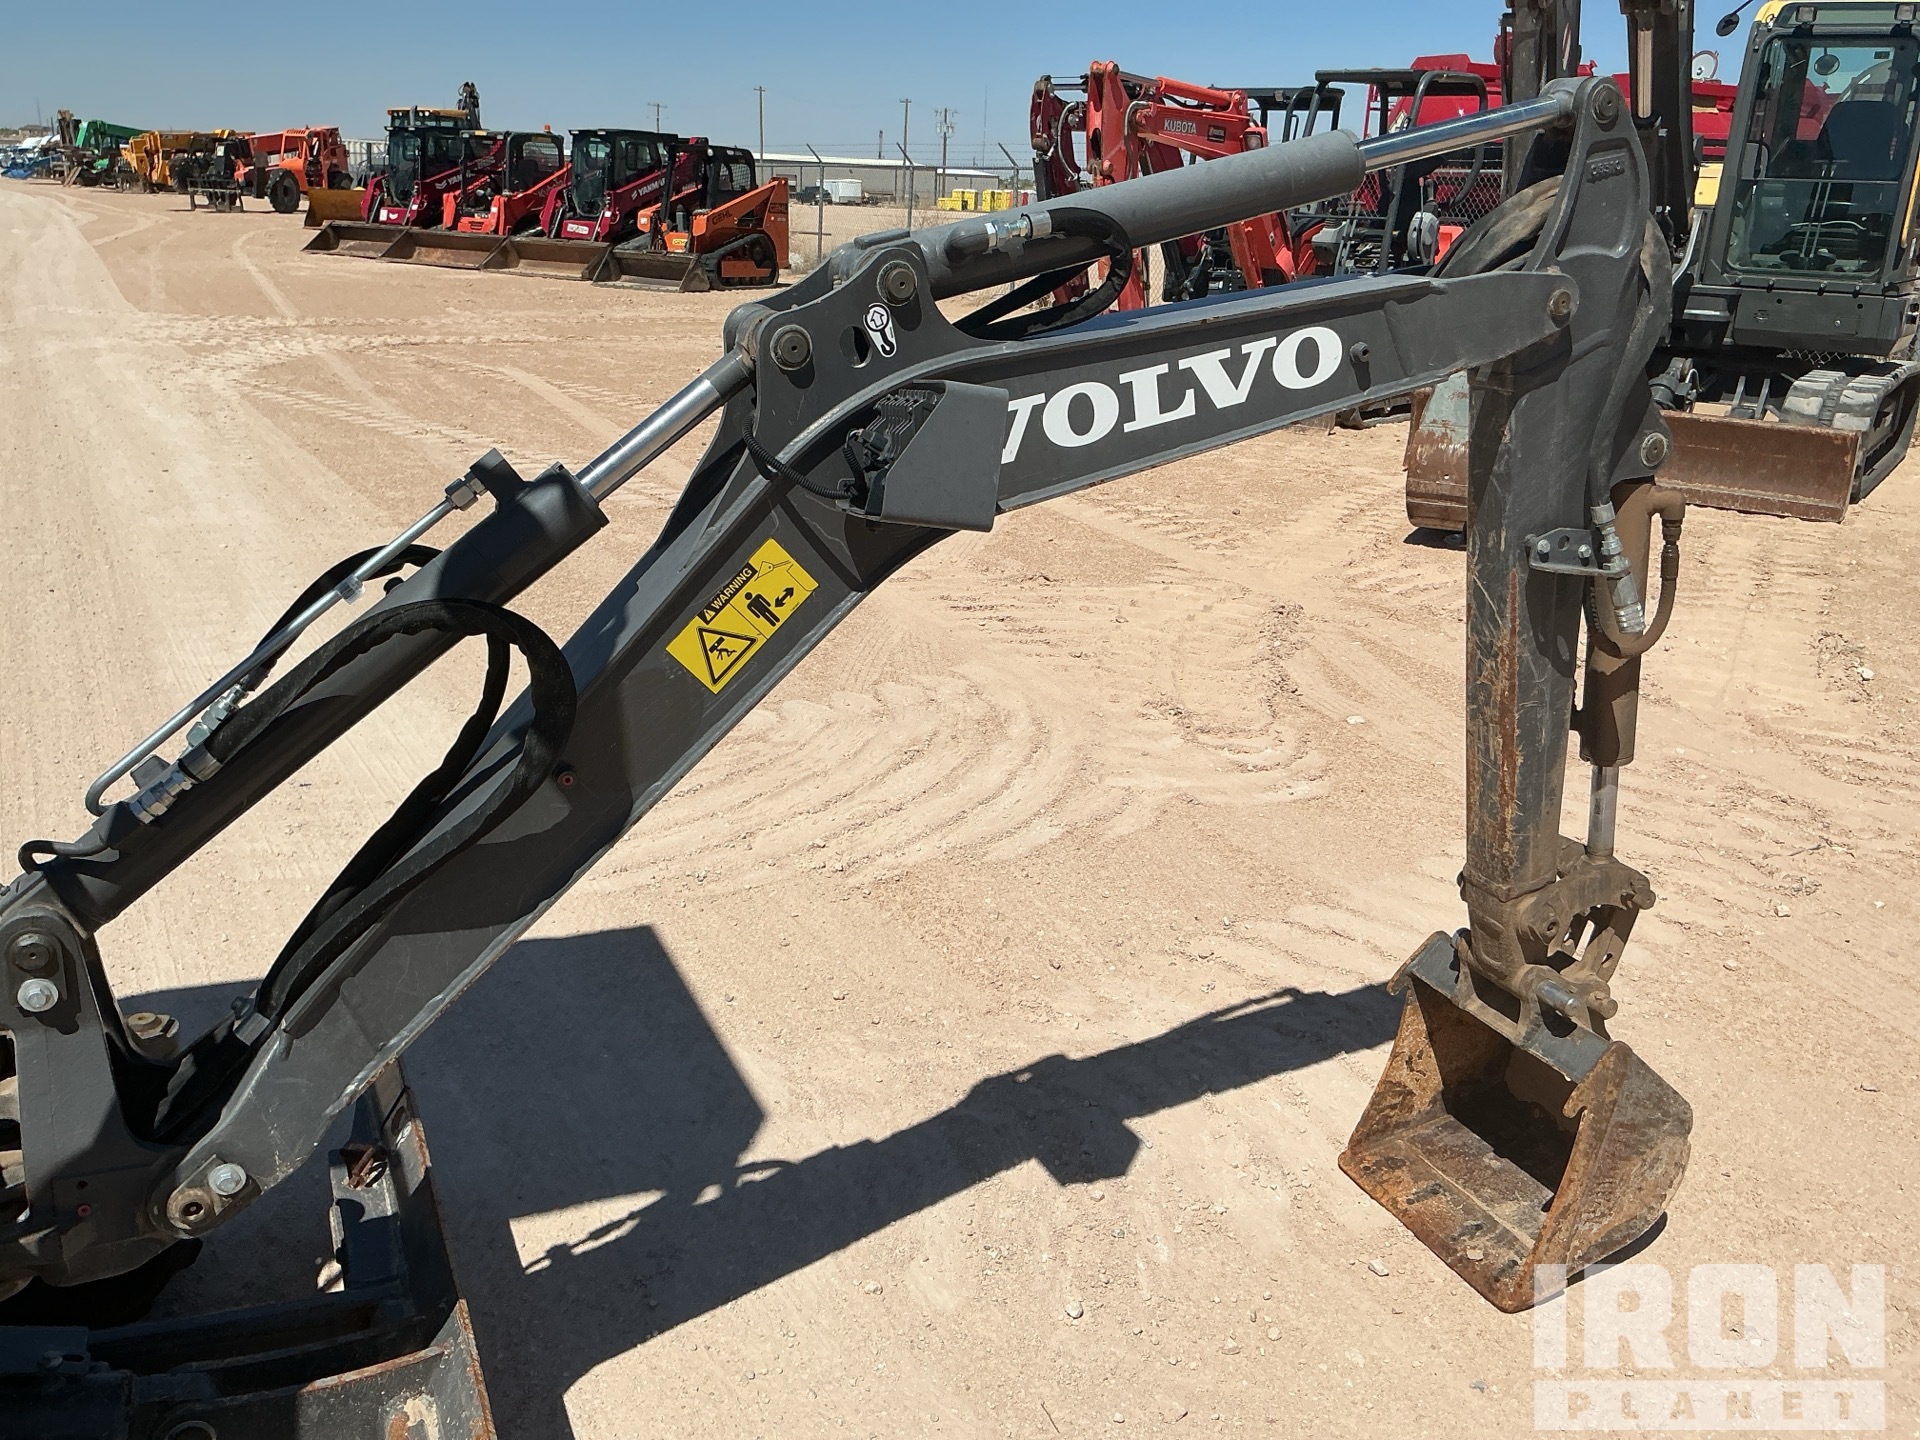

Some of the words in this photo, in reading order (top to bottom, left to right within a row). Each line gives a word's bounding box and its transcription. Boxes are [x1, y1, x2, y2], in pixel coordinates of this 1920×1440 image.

[1164, 119, 1197, 134] KUBOTA
[712, 209, 733, 225] GEHL
[711, 567, 753, 610] WARNING
